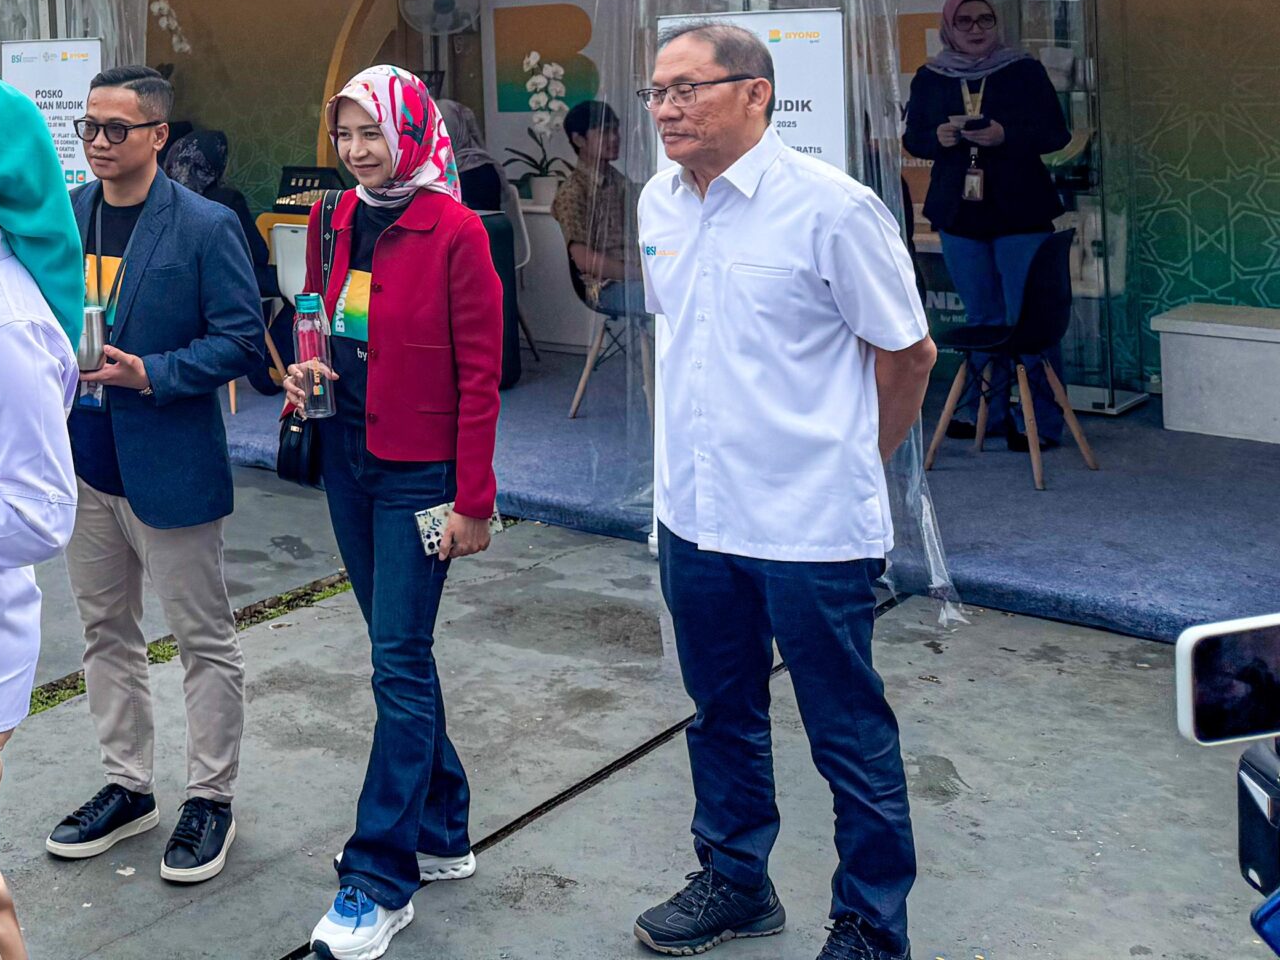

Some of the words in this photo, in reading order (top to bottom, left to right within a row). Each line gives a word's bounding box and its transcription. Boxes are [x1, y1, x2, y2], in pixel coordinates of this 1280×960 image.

[35, 89, 63, 99] POSKO
[55, 101, 83, 110] MUDIK
[773, 100, 812, 112] UDIK
[357, 348, 368, 361] by
